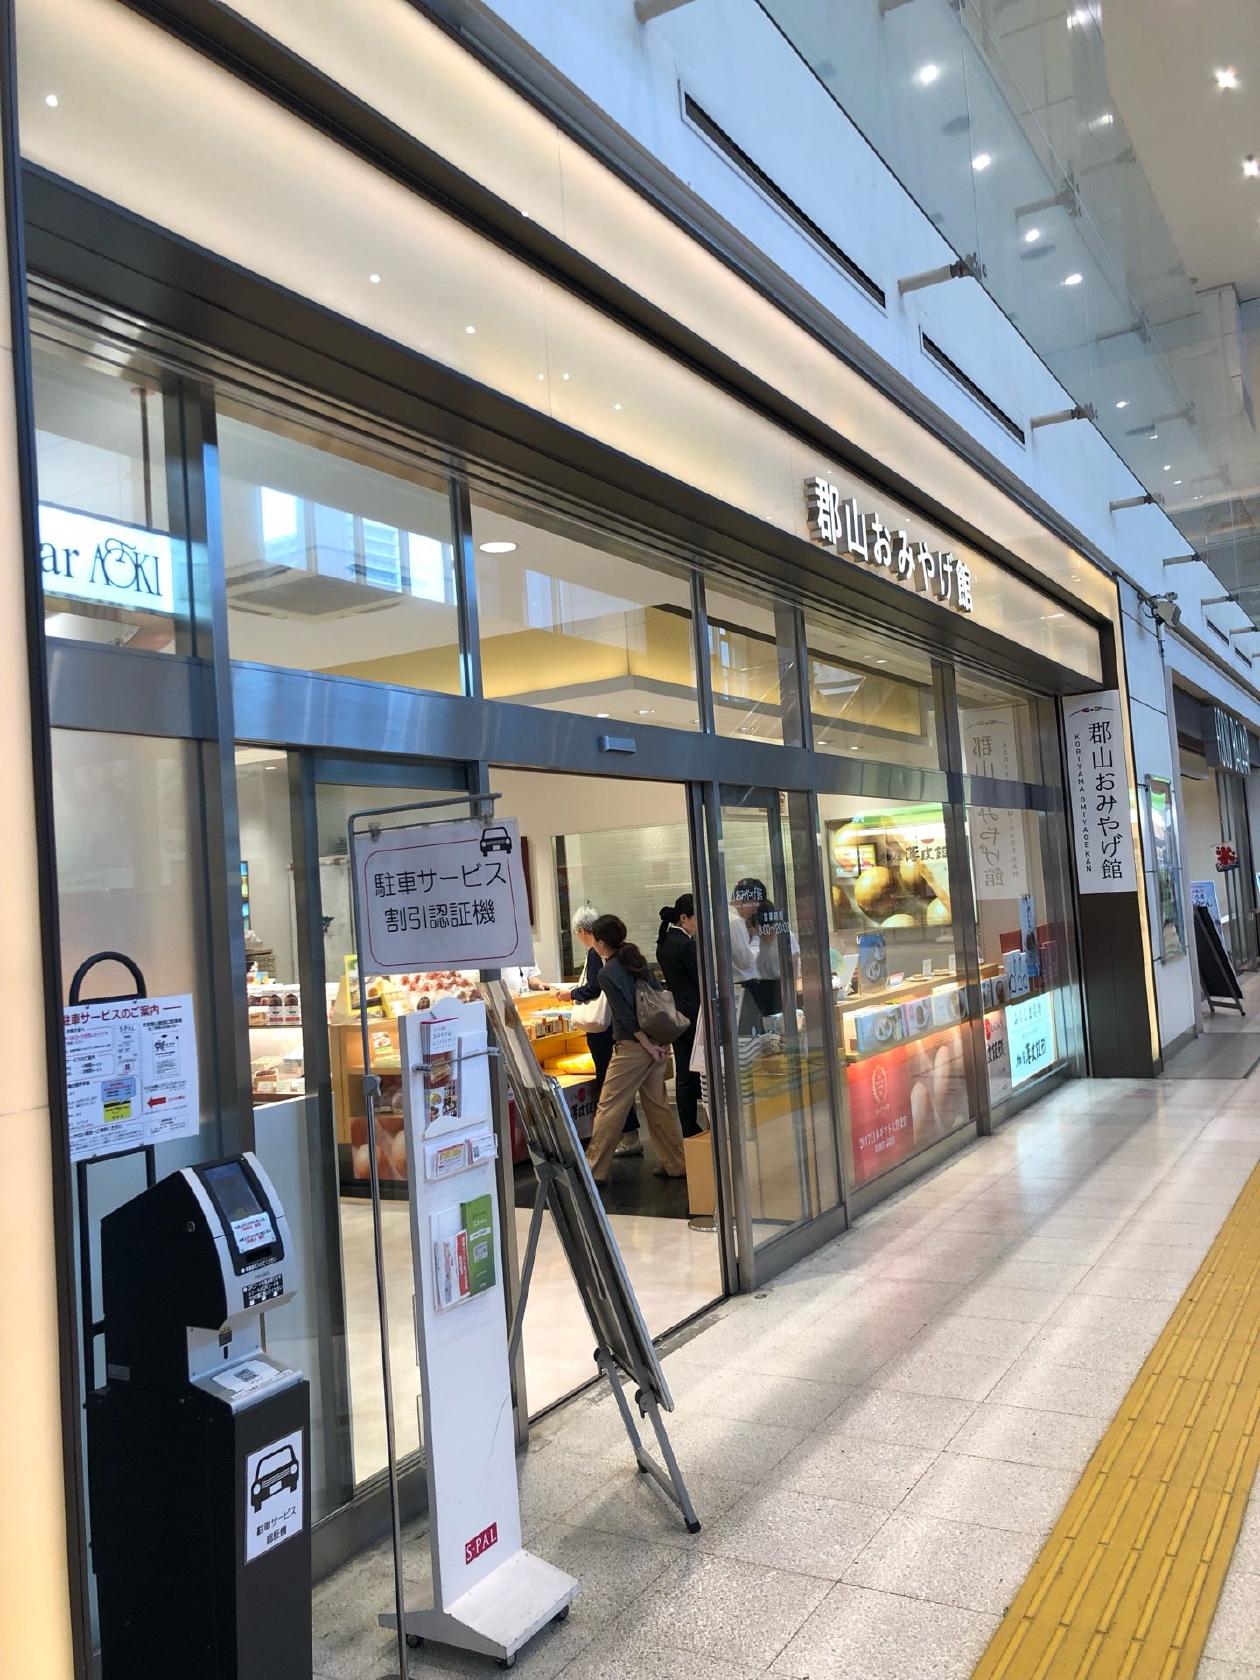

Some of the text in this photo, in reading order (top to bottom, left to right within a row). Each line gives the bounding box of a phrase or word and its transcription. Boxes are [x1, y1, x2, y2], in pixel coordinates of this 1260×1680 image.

[806, 476, 973, 613] 郡山おみやげ館
[1074, 732, 1085, 793] KORIYAMA
[1084, 850, 1092, 873] KAN
[1088, 720, 1124, 880] 郡山おみやげ館
[374, 862, 507, 899] 駐車サービス
[384, 898, 496, 933] 割引認証機
[256, 1505, 297, 1537] 駐車サービス
[466, 1528, 497, 1561] S-PAL
